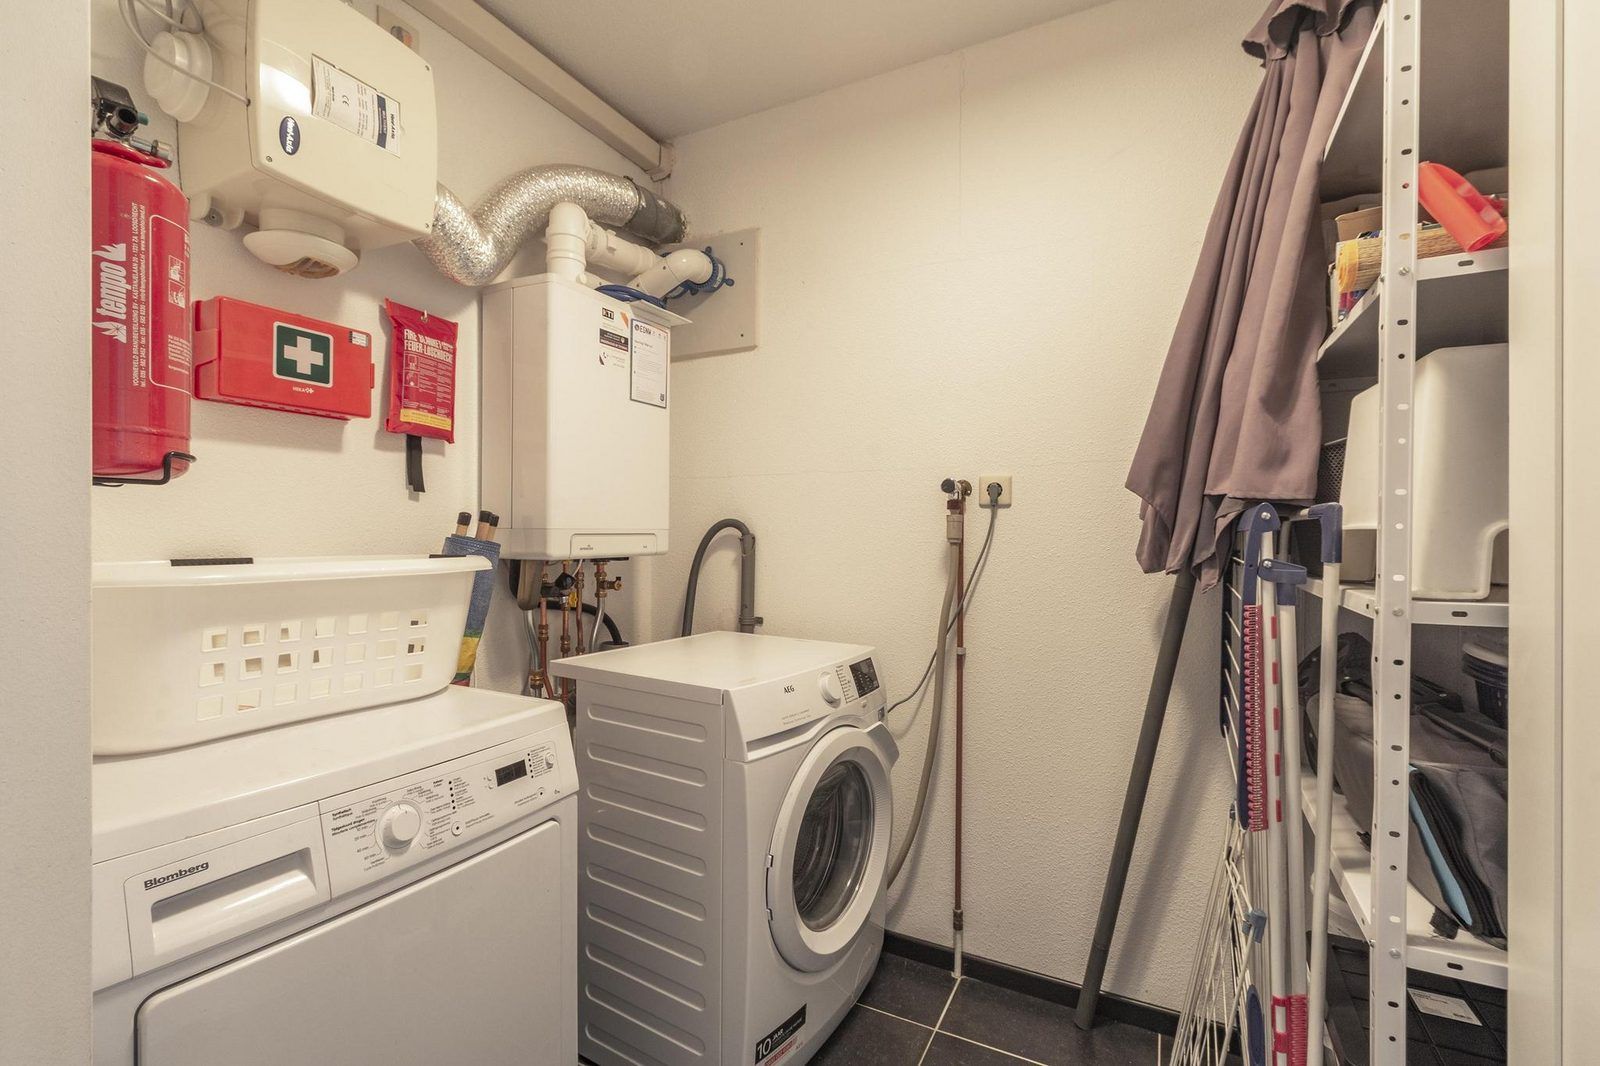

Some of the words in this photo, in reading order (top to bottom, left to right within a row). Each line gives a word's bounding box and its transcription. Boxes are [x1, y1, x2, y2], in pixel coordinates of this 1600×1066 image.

[96, 261, 132, 320] tempo
[784, 685, 795, 694] AEG
[144, 861, 209, 889] Blomberg
[757, 1038, 771, 1060] 10
